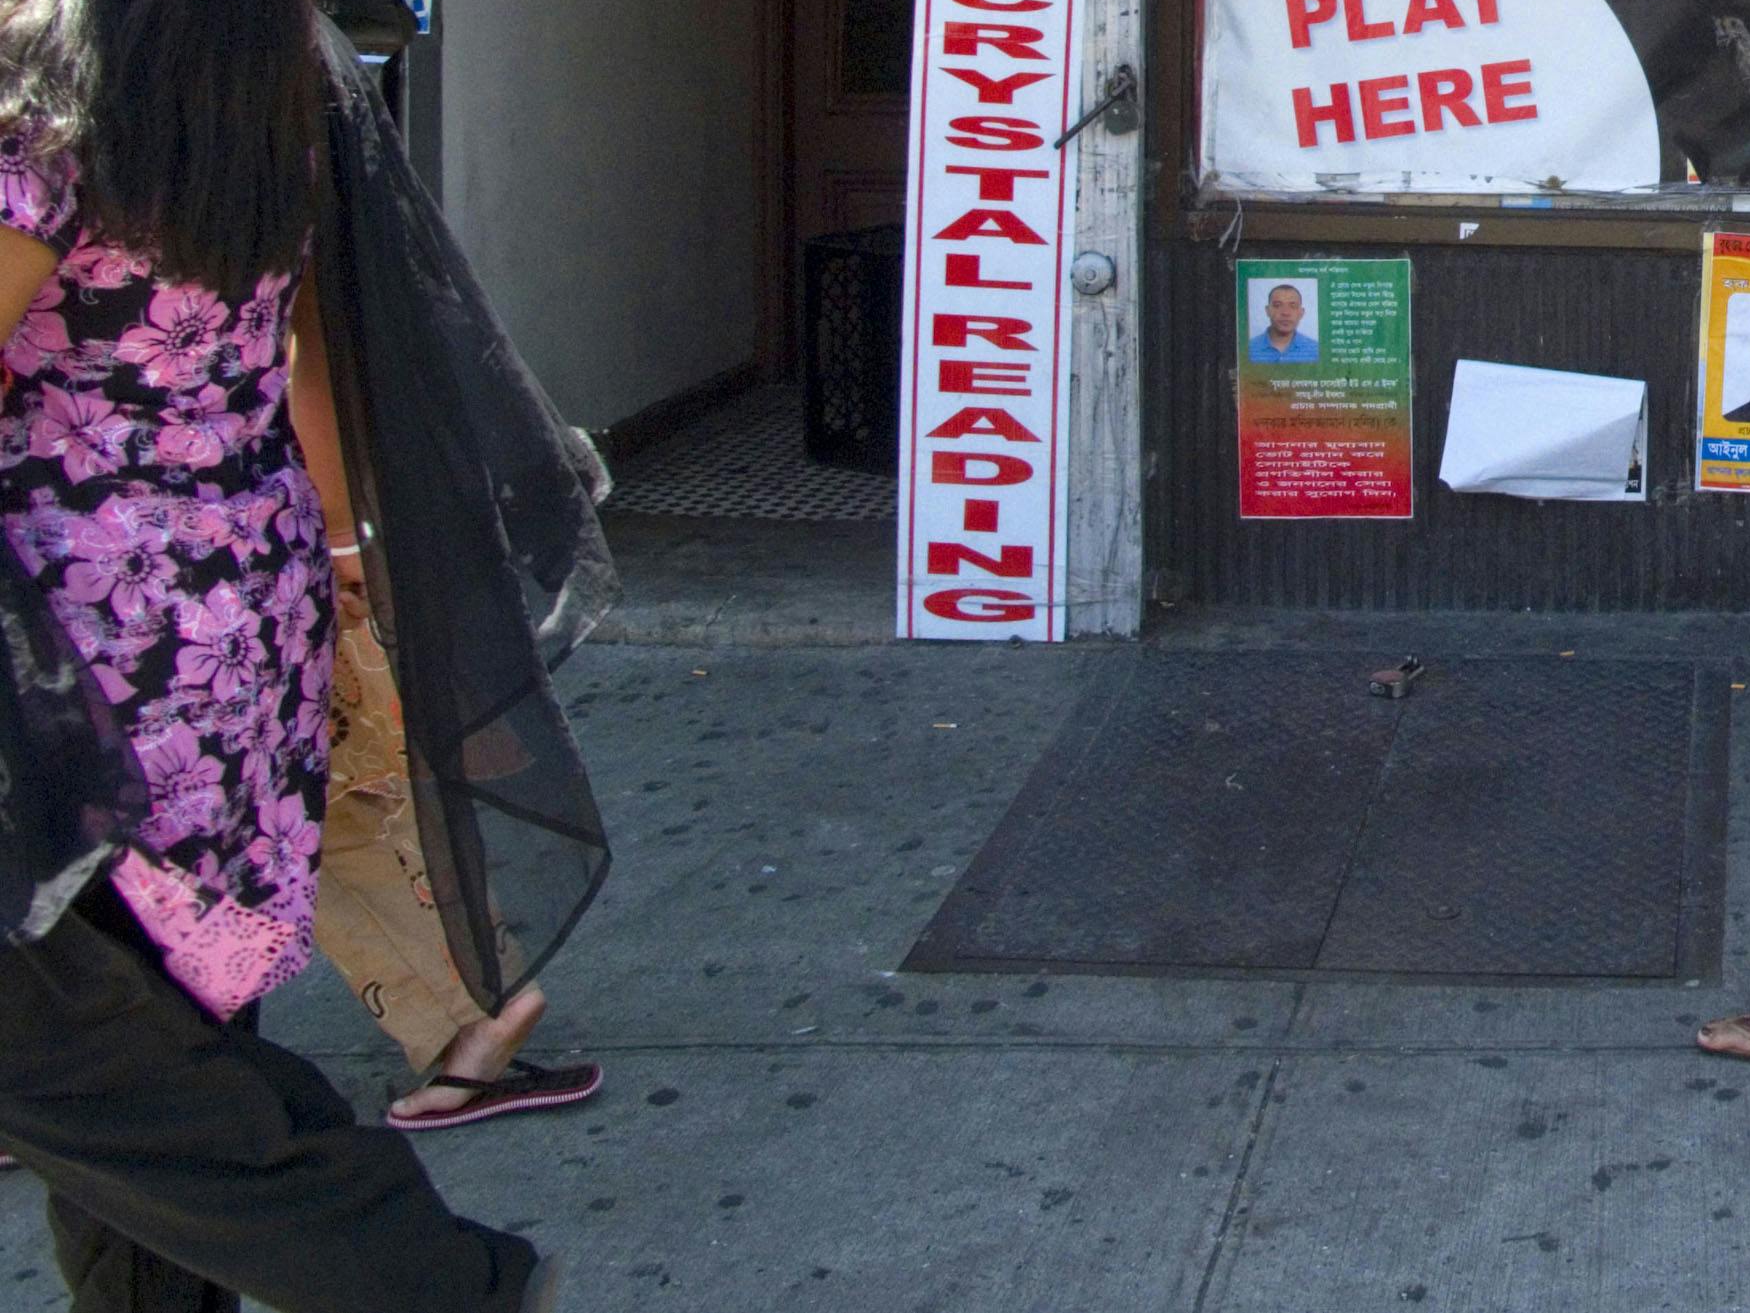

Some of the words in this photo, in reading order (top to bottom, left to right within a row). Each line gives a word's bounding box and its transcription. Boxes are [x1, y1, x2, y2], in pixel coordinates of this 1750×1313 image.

[1291, 57, 1539, 150] HERE
[924, 312, 1042, 623] READING
[1707, 440, 1748, 460] আইনুল
